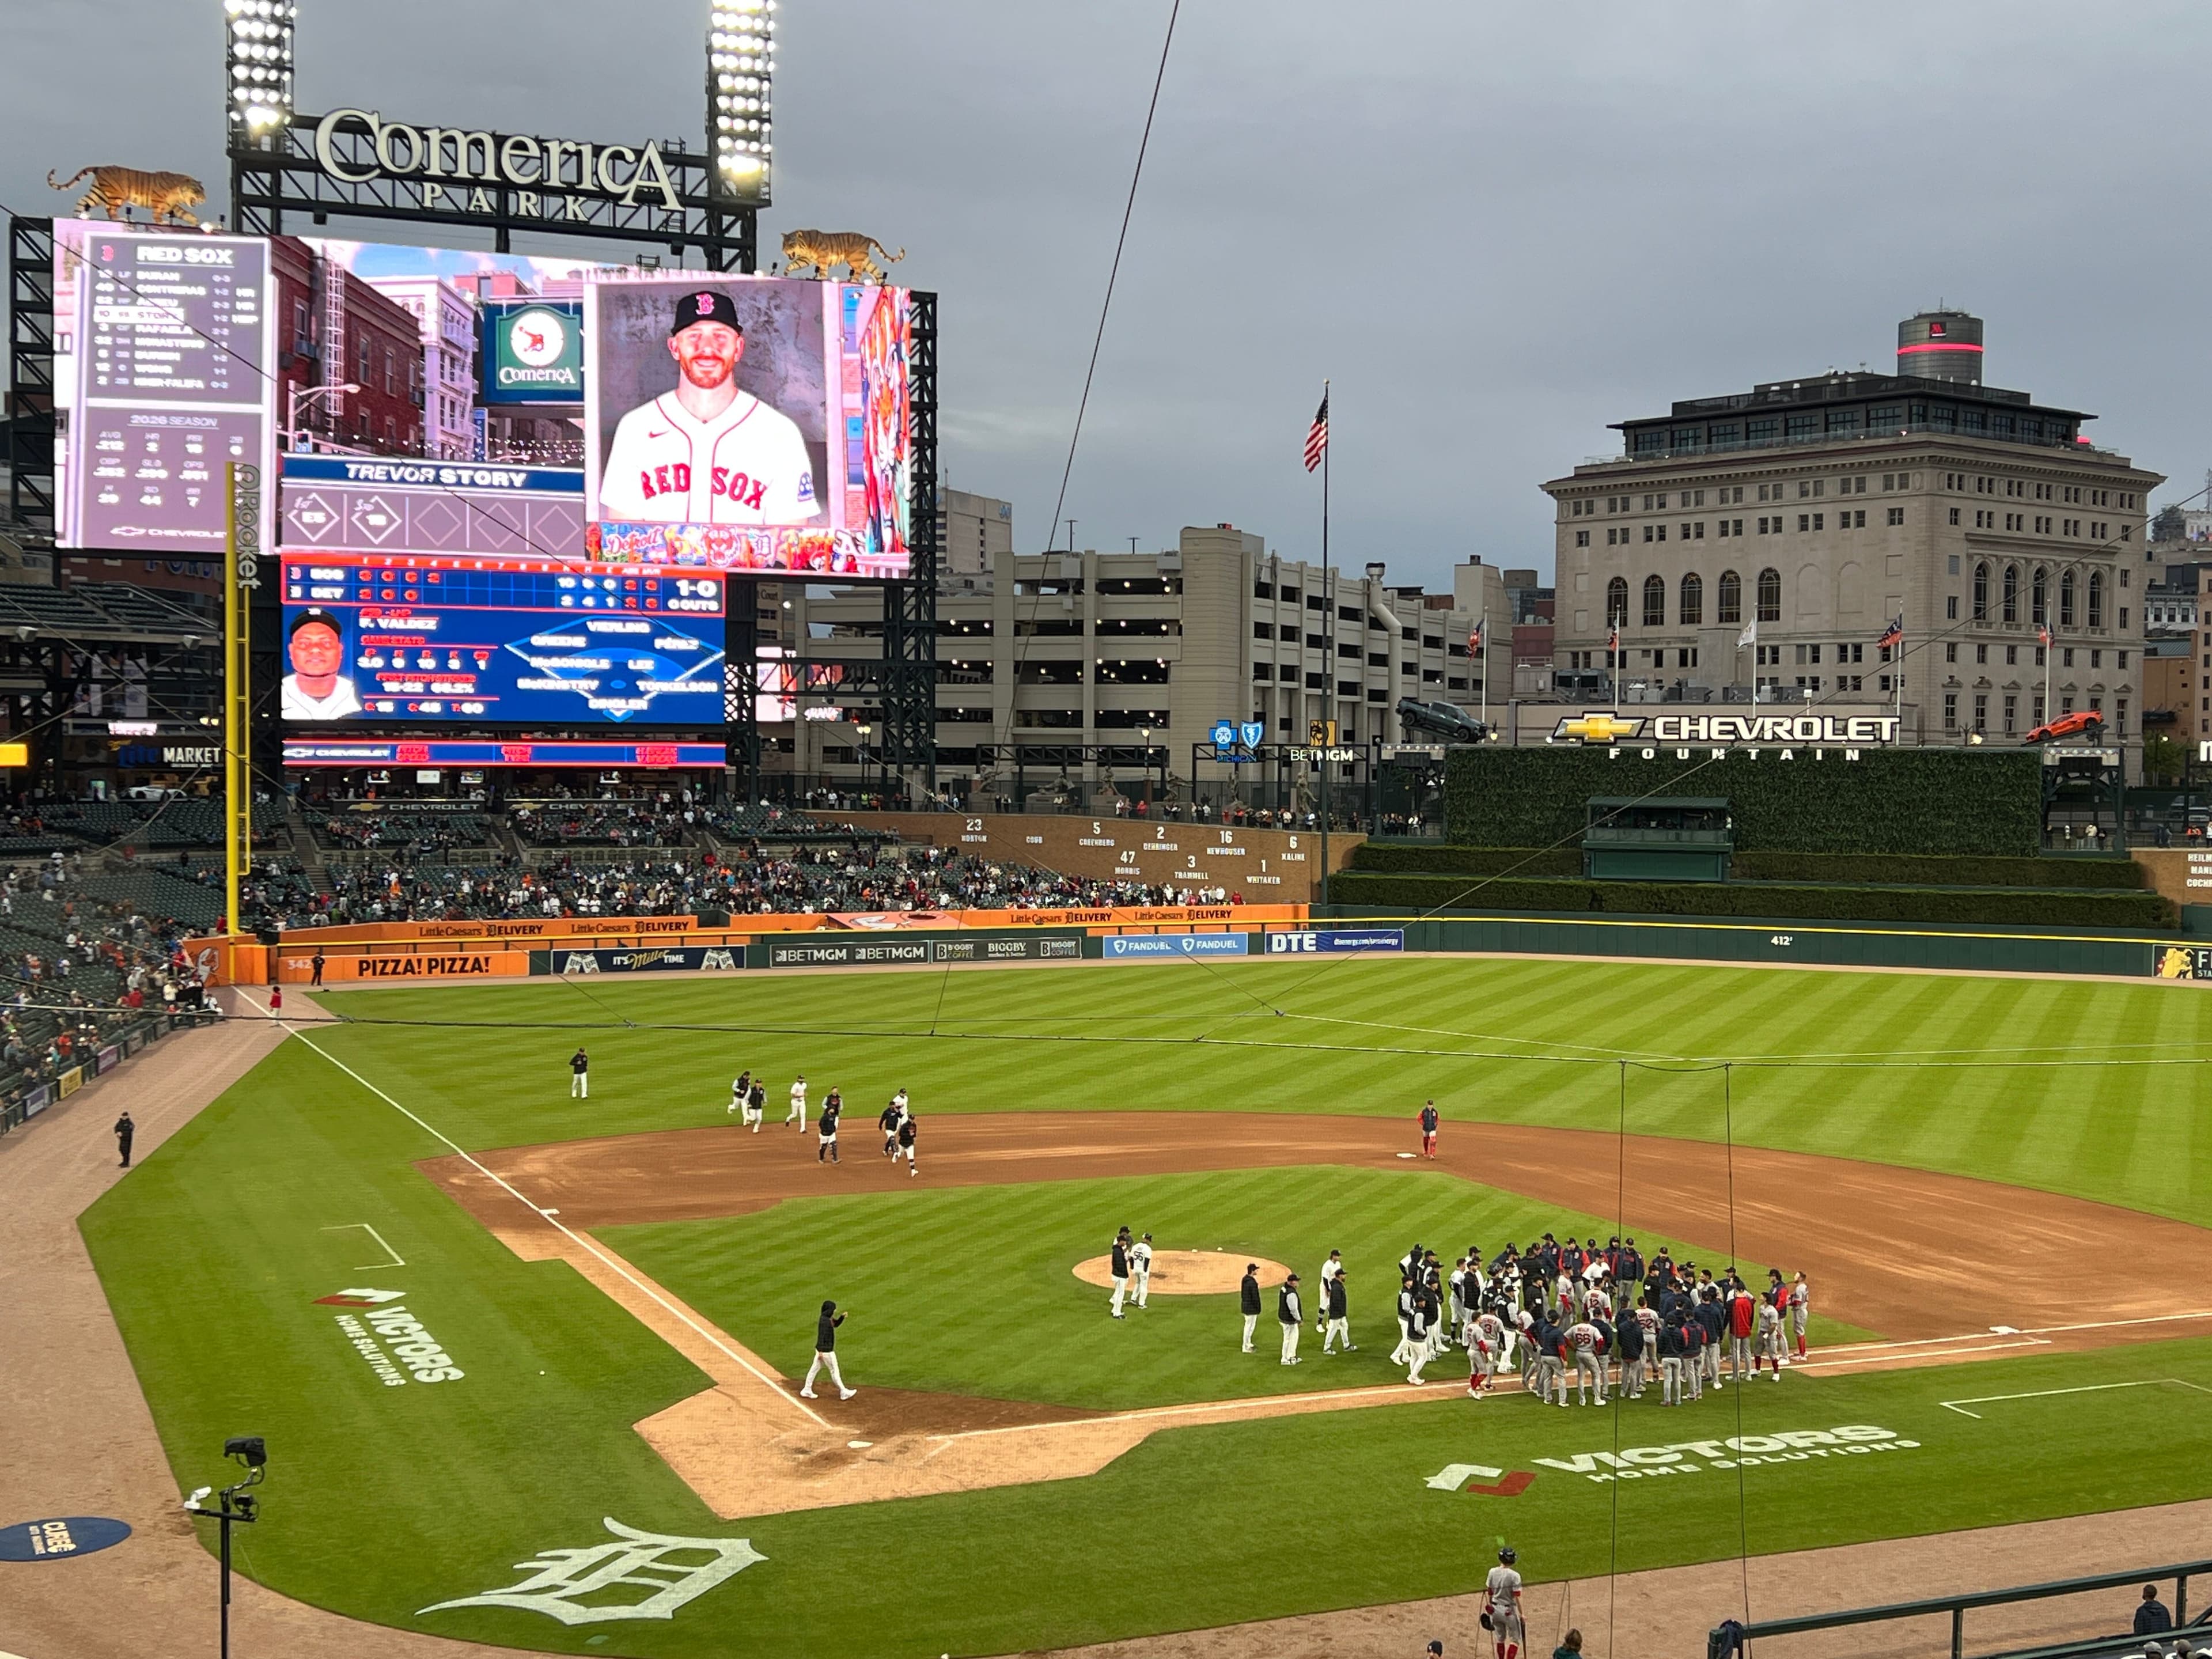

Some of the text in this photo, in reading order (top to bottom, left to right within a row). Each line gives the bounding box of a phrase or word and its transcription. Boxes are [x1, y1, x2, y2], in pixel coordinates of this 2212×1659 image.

[422, 181, 589, 222] PARK
[137, 247, 233, 264] RED SOX
[137, 271, 180, 281] DURAN
[136, 285, 206, 295] CONTRERAS
[236, 288, 255, 297] HR
[236, 302, 255, 310] HR
[695, 294, 714, 315] B
[138, 311, 177, 320] STORY
[135, 325, 193, 335] RAFAELA
[130, 415, 217, 426] 2026 SEASON
[146, 442, 158, 452] 2
[346, 464, 527, 487] TREVOR STORY
[641, 463, 768, 510] RED SOX
[187, 497, 199, 507] 7
[605, 526, 665, 556] Detroit
[310, 569, 717, 596] BOS 0 10 0 1-0
[310, 587, 718, 611] DET 0 0 2 4 1 0 OUTS
[359, 618, 437, 630] F. VALDEZ
[586, 621, 650, 632] VIERLING
[361, 635, 425, 645] GAME STATS
[531, 636, 586, 646] GREENE
[477, 660, 485, 670] 1
[628, 660, 654, 669] LEE
[636, 680, 717, 692] TORKELSON
[589, 699, 647, 710] DINGLER
[1654, 716, 1900, 741] CHEVROLET
[162, 747, 221, 762] MARKET
[1217, 755, 1257, 763] MICHIGAN
[1290, 749, 1353, 762] BETMGM
[1609, 748, 1859, 761] FOUNTAIN
[967, 819, 982, 831] 23
[1093, 822, 1100, 835] 5
[1157, 827, 1164, 839] 2
[1220, 831, 1233, 844] 16
[1026, 836, 1043, 844] COBB
[1079, 838, 1115, 847] GREENBERG
[1290, 836, 1297, 849] 6
[1143, 843, 1178, 851] GEHRINGER
[1207, 847, 1245, 855] NEWHOUSER
[1120, 851, 1135, 863] 47
[1188, 855, 1195, 868] 3
[1282, 853, 1305, 861] KALINE
[1115, 867, 1141, 875] MORRIS
[1261, 859, 1266, 872] 1
[1175, 872, 1209, 880] TRAMMELL
[1247, 876, 1281, 885] WHITAKER
[1011, 911, 1112, 924] Little Caesars DELIVERY
[1135, 910, 1232, 921] Little Caesars DELIVERY
[419, 925, 544, 937] Little Caesars DELIVERY
[571, 921, 689, 933] Little Caesars DELIVERY
[1129, 941, 1171, 950] FANDUEL
[1196, 940, 1237, 949] FANDUEL
[1272, 934, 1317, 952] DTE
[1771, 935, 1793, 945] 412'
[867, 946, 925, 960] BETMGM
[988, 943, 1027, 952] BIGGBY
[613, 950, 684, 969] IT'S Miller TIME
[788, 949, 847, 961] BETMGM
[2198, 951, 2212, 968] F
[287, 959, 312, 970] 342
[358, 956, 490, 976] PIZZA! PIZZA!
[365, 1306, 465, 1382] VICTORS
[1575, 1333, 1590, 1344] 66
[334, 1315, 407, 1386] HOME SOLUTIONS
[1531, 1425, 1898, 1473] VICTORS
[1586, 1440, 1922, 1483] HOME SOLUTIONS
